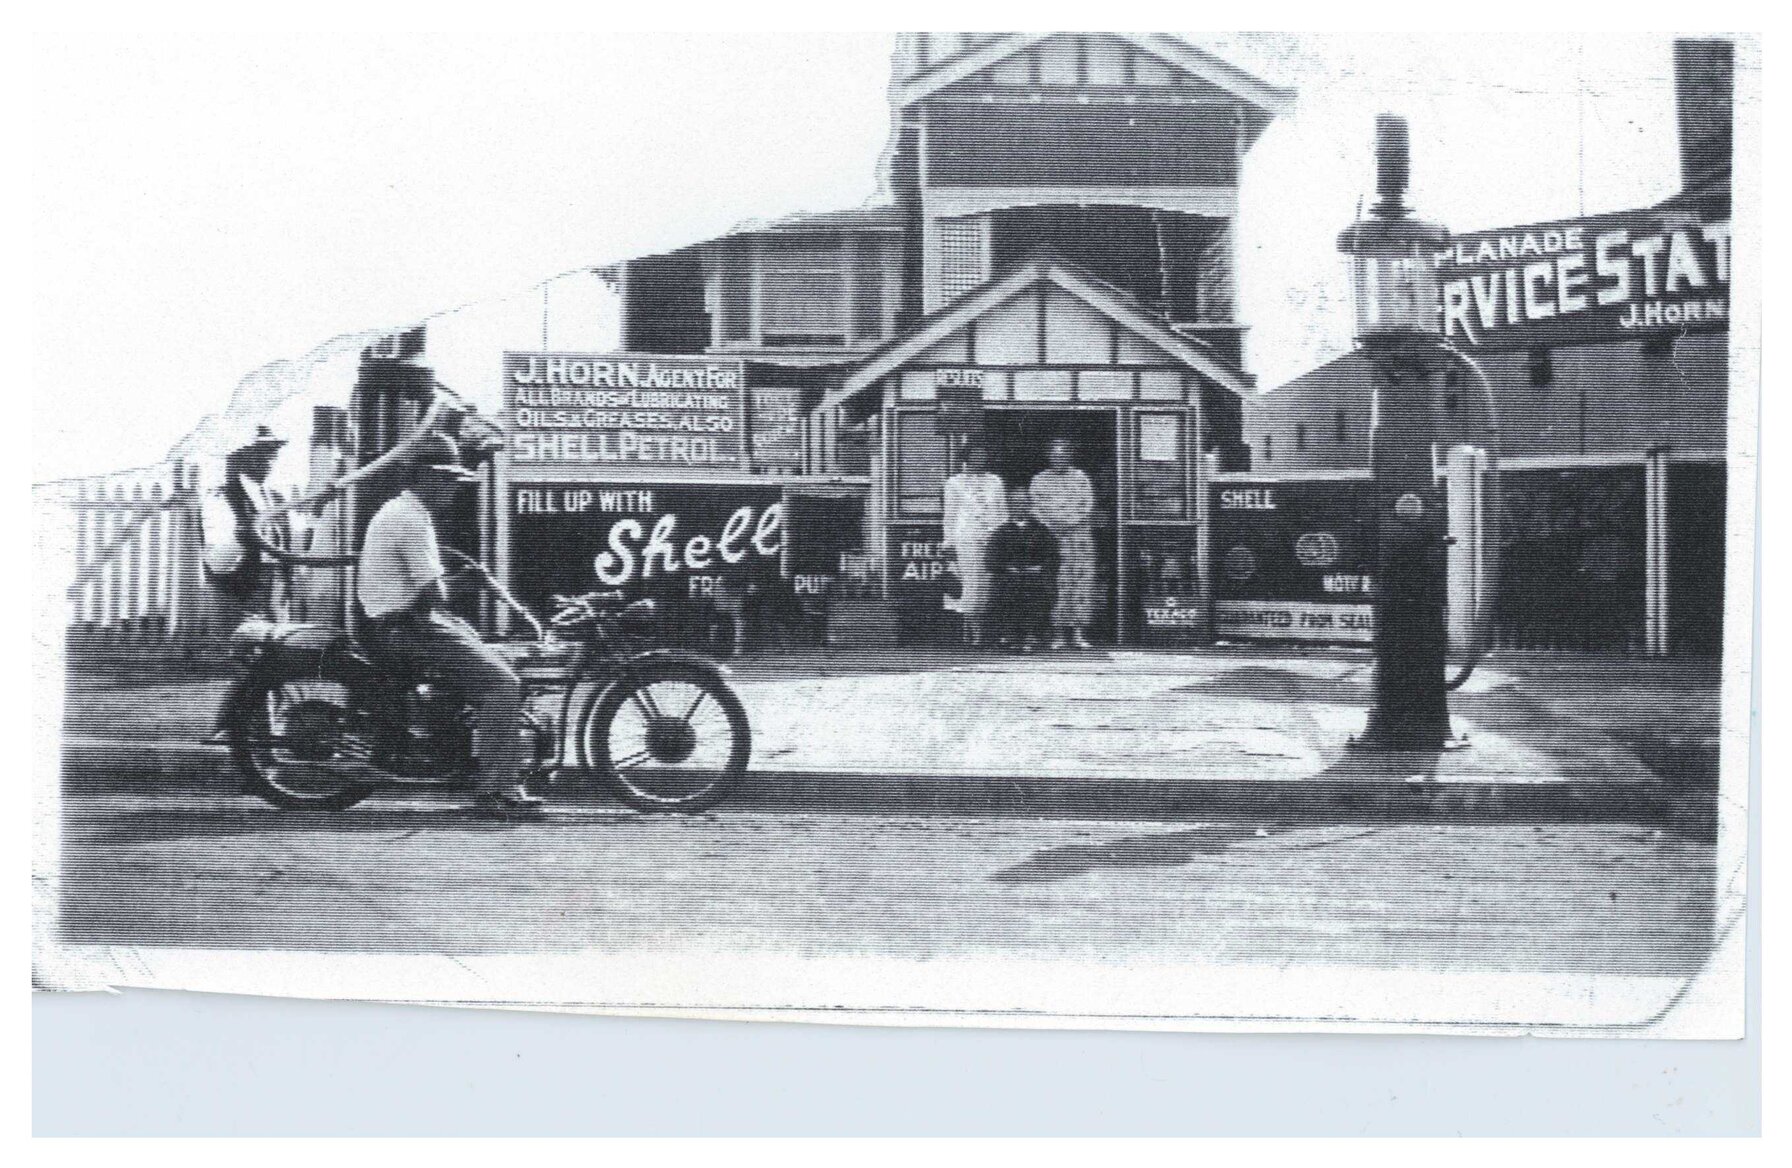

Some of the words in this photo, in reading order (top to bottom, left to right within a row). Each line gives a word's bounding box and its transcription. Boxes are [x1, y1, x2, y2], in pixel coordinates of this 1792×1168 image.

[1597, 224, 1730, 304] STAT
[516, 388, 548, 406] ALL
[551, 388, 617, 407] BRANDS
[632, 390, 729, 410] LUBRICATING
[516, 409, 567, 428] OILS
[679, 415, 733, 432] ALSO
[514, 433, 618, 463] SHELL
[518, 489, 557, 513] FILL
[564, 490, 592, 512] UP
[600, 489, 651, 513] WITH
[1221, 490, 1276, 509] SHELL
[594, 503, 784, 585] Shell
[1300, 612, 1333, 628] FROM
